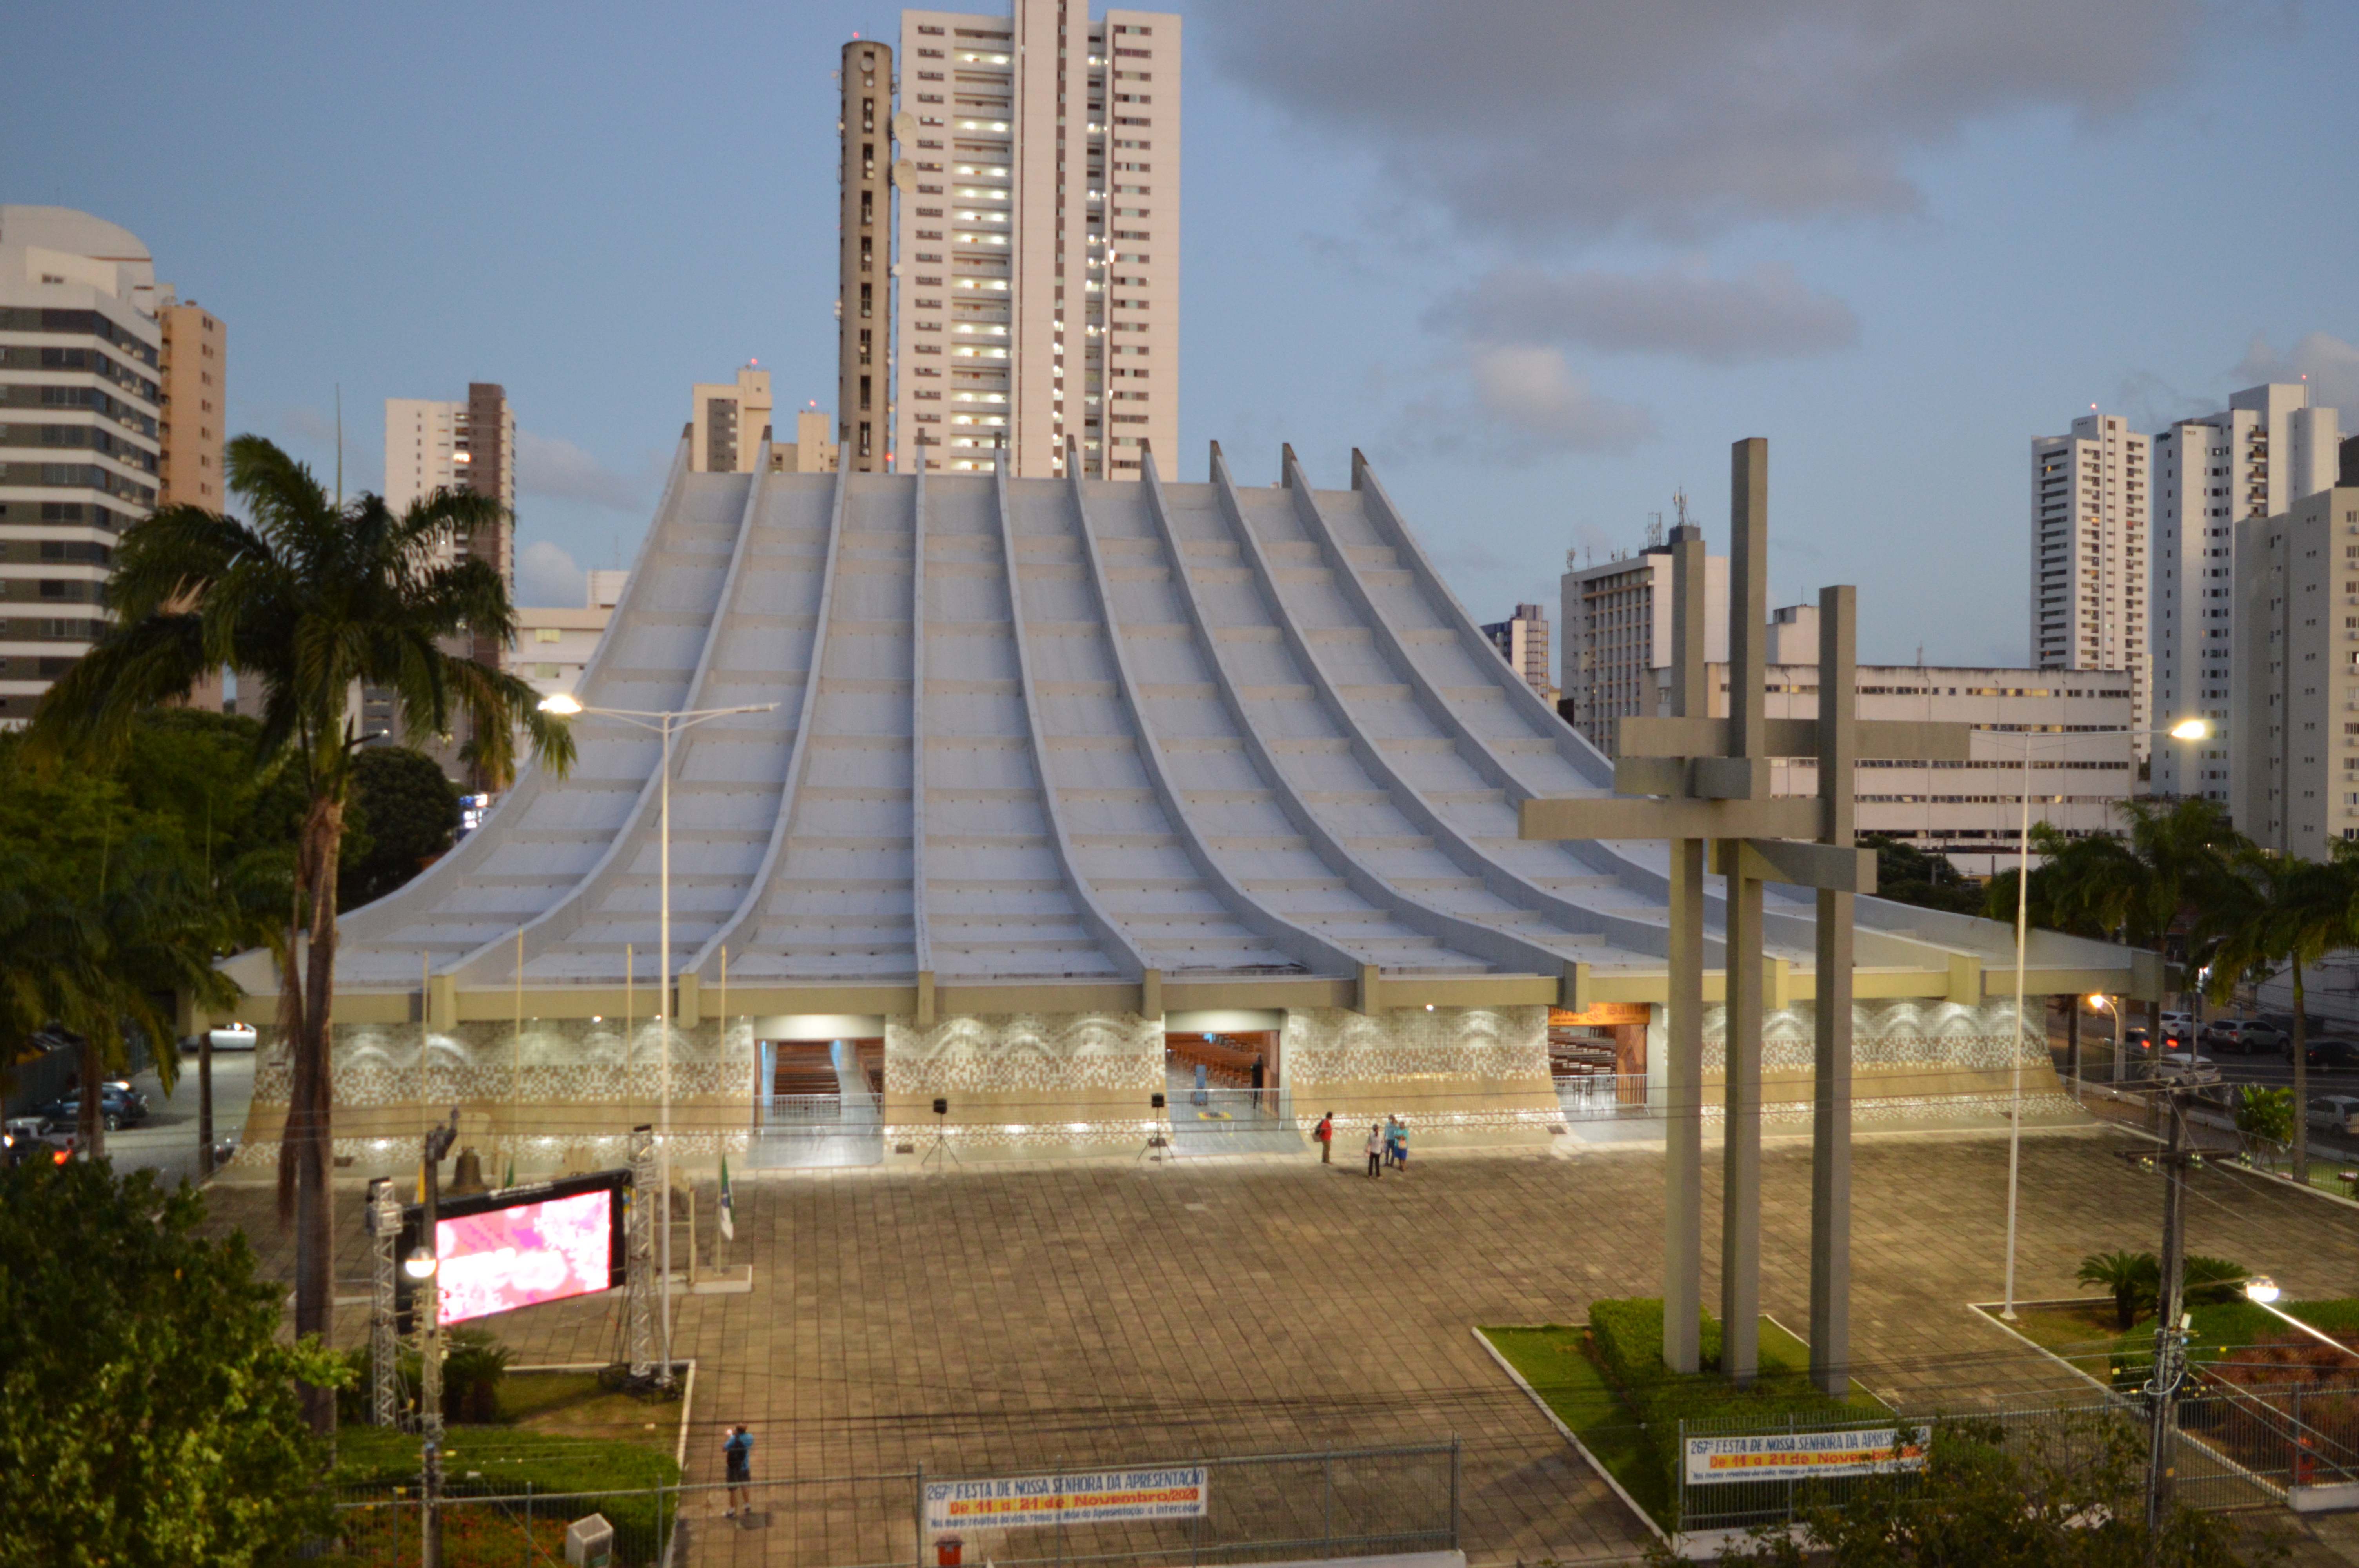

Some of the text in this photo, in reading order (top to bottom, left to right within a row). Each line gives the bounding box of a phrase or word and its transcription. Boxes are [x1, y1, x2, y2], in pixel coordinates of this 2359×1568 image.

[1716, 1439, 1747, 1454] FESTA
[1750, 1438, 1762, 1451] DE
[1766, 1437, 1795, 1451] NOSSA
[1798, 1434, 1843, 1450] SENHORA
[1846, 1433, 1859, 1448] DA
[1710, 1455, 1726, 1468] De
[1732, 1455, 1746, 1467] 11
[1753, 1457, 1762, 1466] a
[1769, 1453, 1786, 1465] 21
[1790, 1452, 1810, 1465] de
[956, 1482, 992, 1499] FESTA
[997, 1481, 1011, 1497] DE
[1015, 1479, 1049, 1496] NOSSA
[1053, 1475, 1103, 1493] SENHORA
[1107, 1474, 1121, 1490] DA
[1125, 1469, 1204, 1488] APRESENTAÇÃO
[950, 1488, 1199, 1515] De 11 a 21 de Novembro/2020
